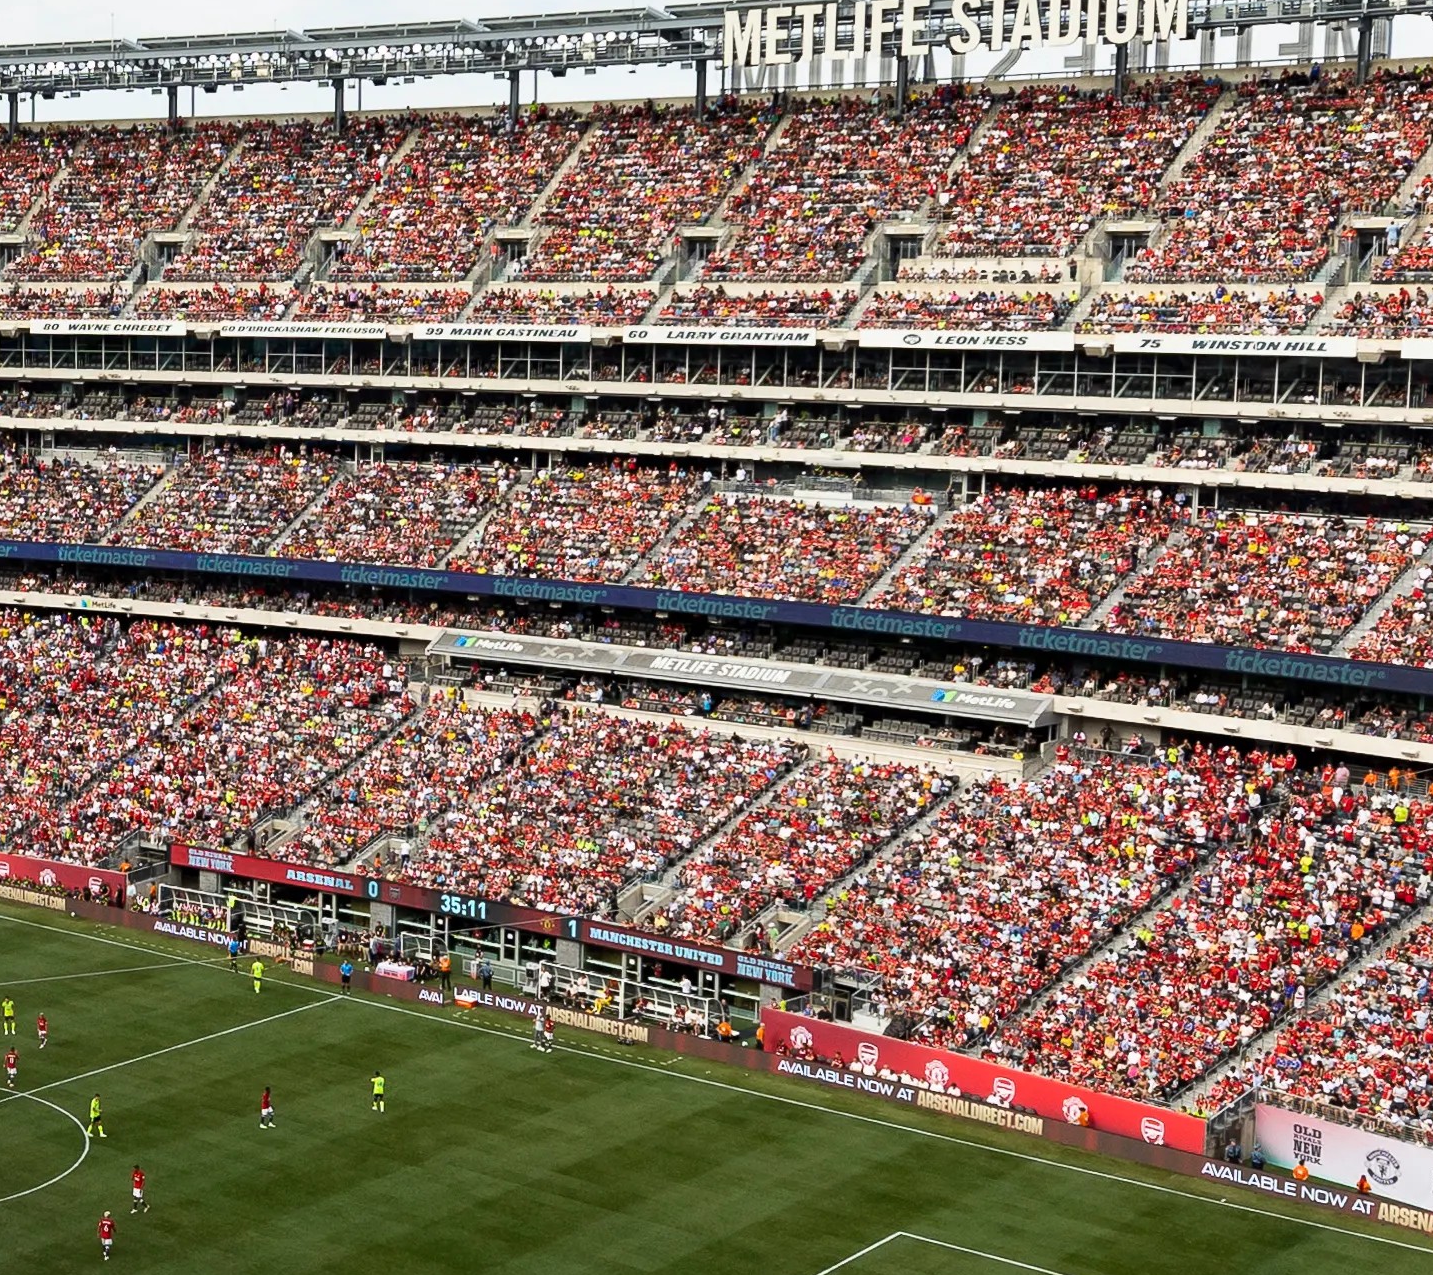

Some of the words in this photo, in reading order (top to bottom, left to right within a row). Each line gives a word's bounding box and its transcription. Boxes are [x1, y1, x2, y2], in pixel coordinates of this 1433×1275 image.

[43, 323, 59, 331] 80
[68, 323, 110, 331] WAYNE
[113, 324, 173, 332] CHREBET
[324, 326, 385, 335] FERGUSON
[425, 328, 443, 336] 99
[449, 328, 496, 336] MARK
[499, 329, 578, 338] GASTINEAU
[628, 330, 648, 339] 60
[666, 331, 726, 340] LARRY
[728, 332, 810, 342] GRANTHAM
[934, 335, 981, 345] LEON
[983, 336, 1029, 345] HESS
[1139, 339, 1162, 349] 75
[1191, 340, 1282, 351] WINSTON
[1284, 341, 1328, 352] HILL
[92, 600, 117, 609] MetLife
[475, 638, 524, 652] MetLife
[651, 655, 719, 675] METLIFE
[718, 664, 792, 683] STADIUM
[955, 693, 1016, 709] MetLife
[286, 868, 353, 891] ARSENAL
[368, 881, 378, 898] 0
[440, 894, 486, 919] 35:11
[153, 920, 207, 943] AVAILABLE
[569, 919, 576, 937] 1
[589, 927, 673, 954] MANCHESTER
[674, 944, 724, 966] UNITED
[737, 955, 754, 965] OLD
[737, 963, 764, 980] NEW
[764, 969, 795, 987] YORK.
[494, 996, 524, 1013] NOW
[525, 1002, 543, 1016] AT
[545, 1006, 648, 1041] ARSENALDIRECT.COM
[777, 1058, 855, 1087] AVAILABLE
[856, 1076, 894, 1096] NOW
[896, 1086, 915, 1102] AT
[916, 1088, 1044, 1136] ARSENALDIRECT.COM
[1293, 1123, 1322, 1139] OLD
[1293, 1139, 1322, 1157] NEW
[1202, 1161, 1297, 1200] AVAILABLE
[1299, 1183, 1348, 1209] NOW
[1351, 1195, 1375, 1215] AT
